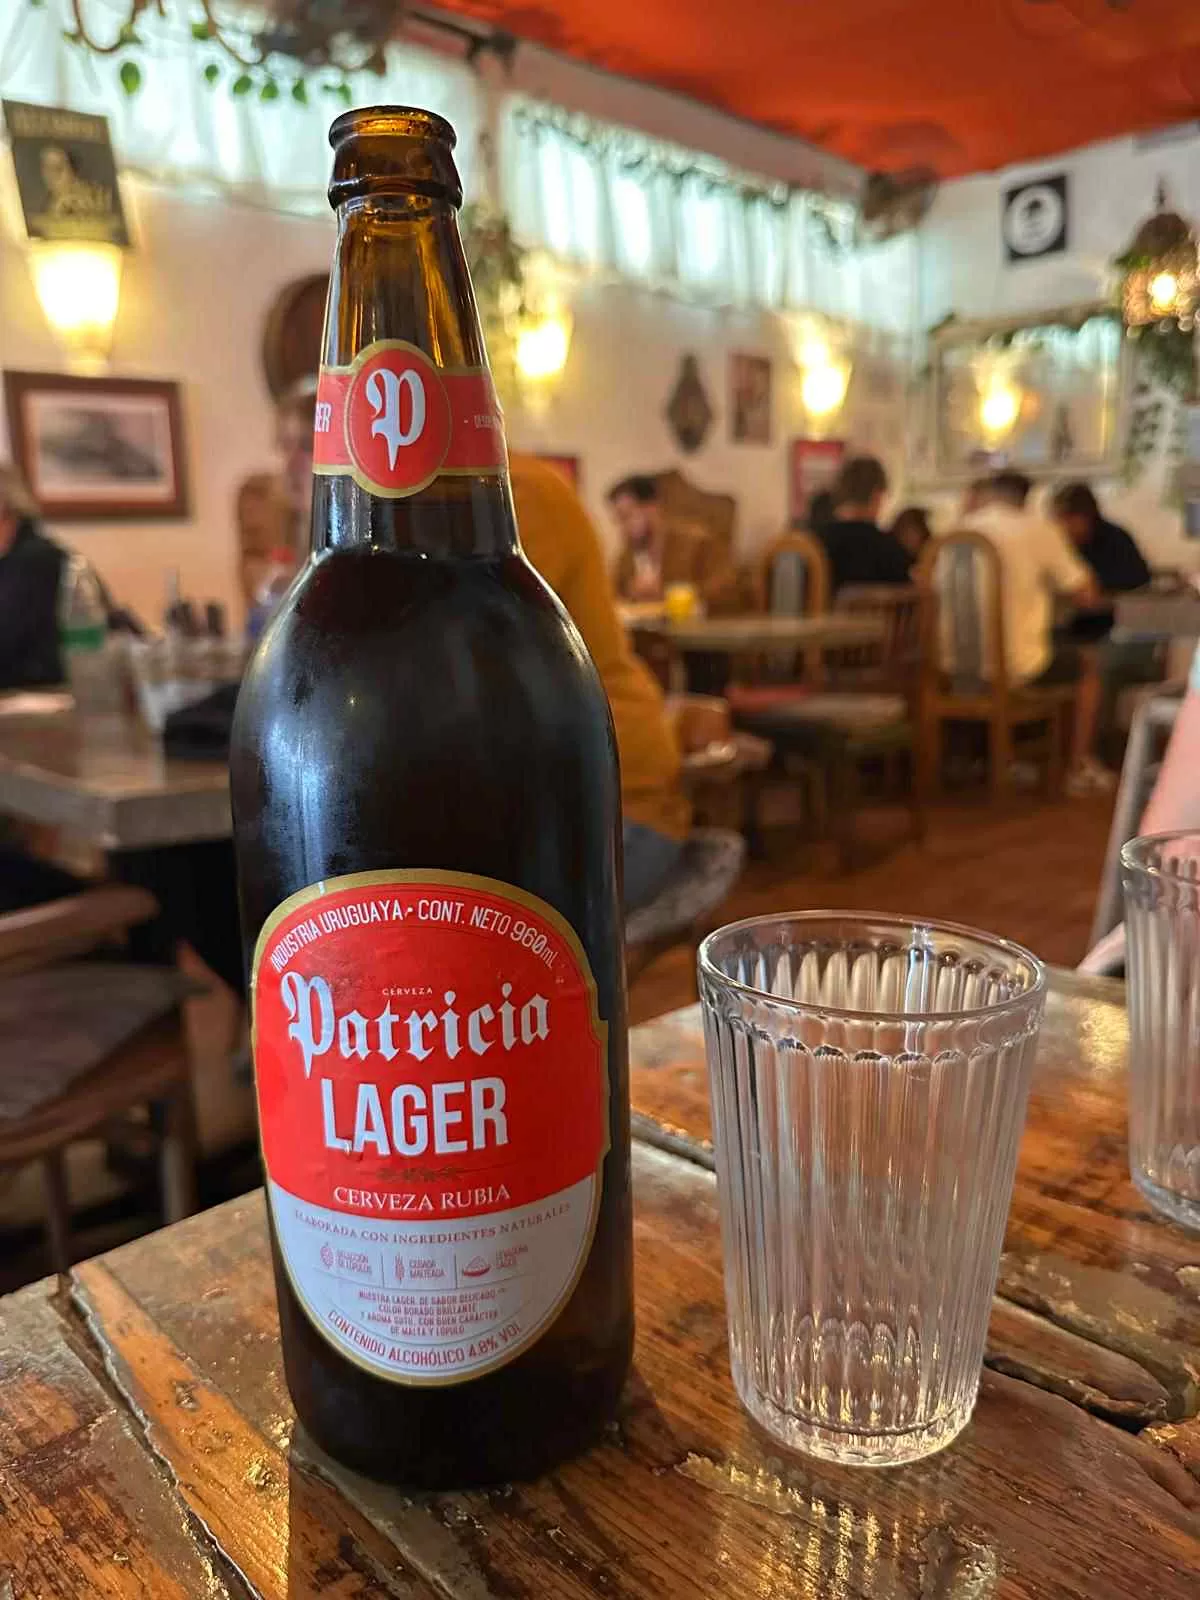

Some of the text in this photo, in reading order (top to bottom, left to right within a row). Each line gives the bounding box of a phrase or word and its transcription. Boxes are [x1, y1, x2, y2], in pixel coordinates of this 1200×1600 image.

[366, 368, 426, 472] P
[270, 922, 322, 973] INDUSTRIA
[321, 900, 403, 934] URUGUAYA
[417, 900, 465, 924] CONT.
[471, 906, 512, 935] NETO
[382, 986, 434, 997] CERVEZA
[280, 971, 550, 1079] Patricia
[320, 1077, 509, 1157] LAGER
[295, 1203, 571, 1245] ELABORADA CON INGREDIENTES NATURALES
[333, 1184, 511, 1211] CERVEZA RUBIA
[328, 1310, 385, 1357] CONTENIDO
[388, 1346, 465, 1367] ALCOHÓLICO
